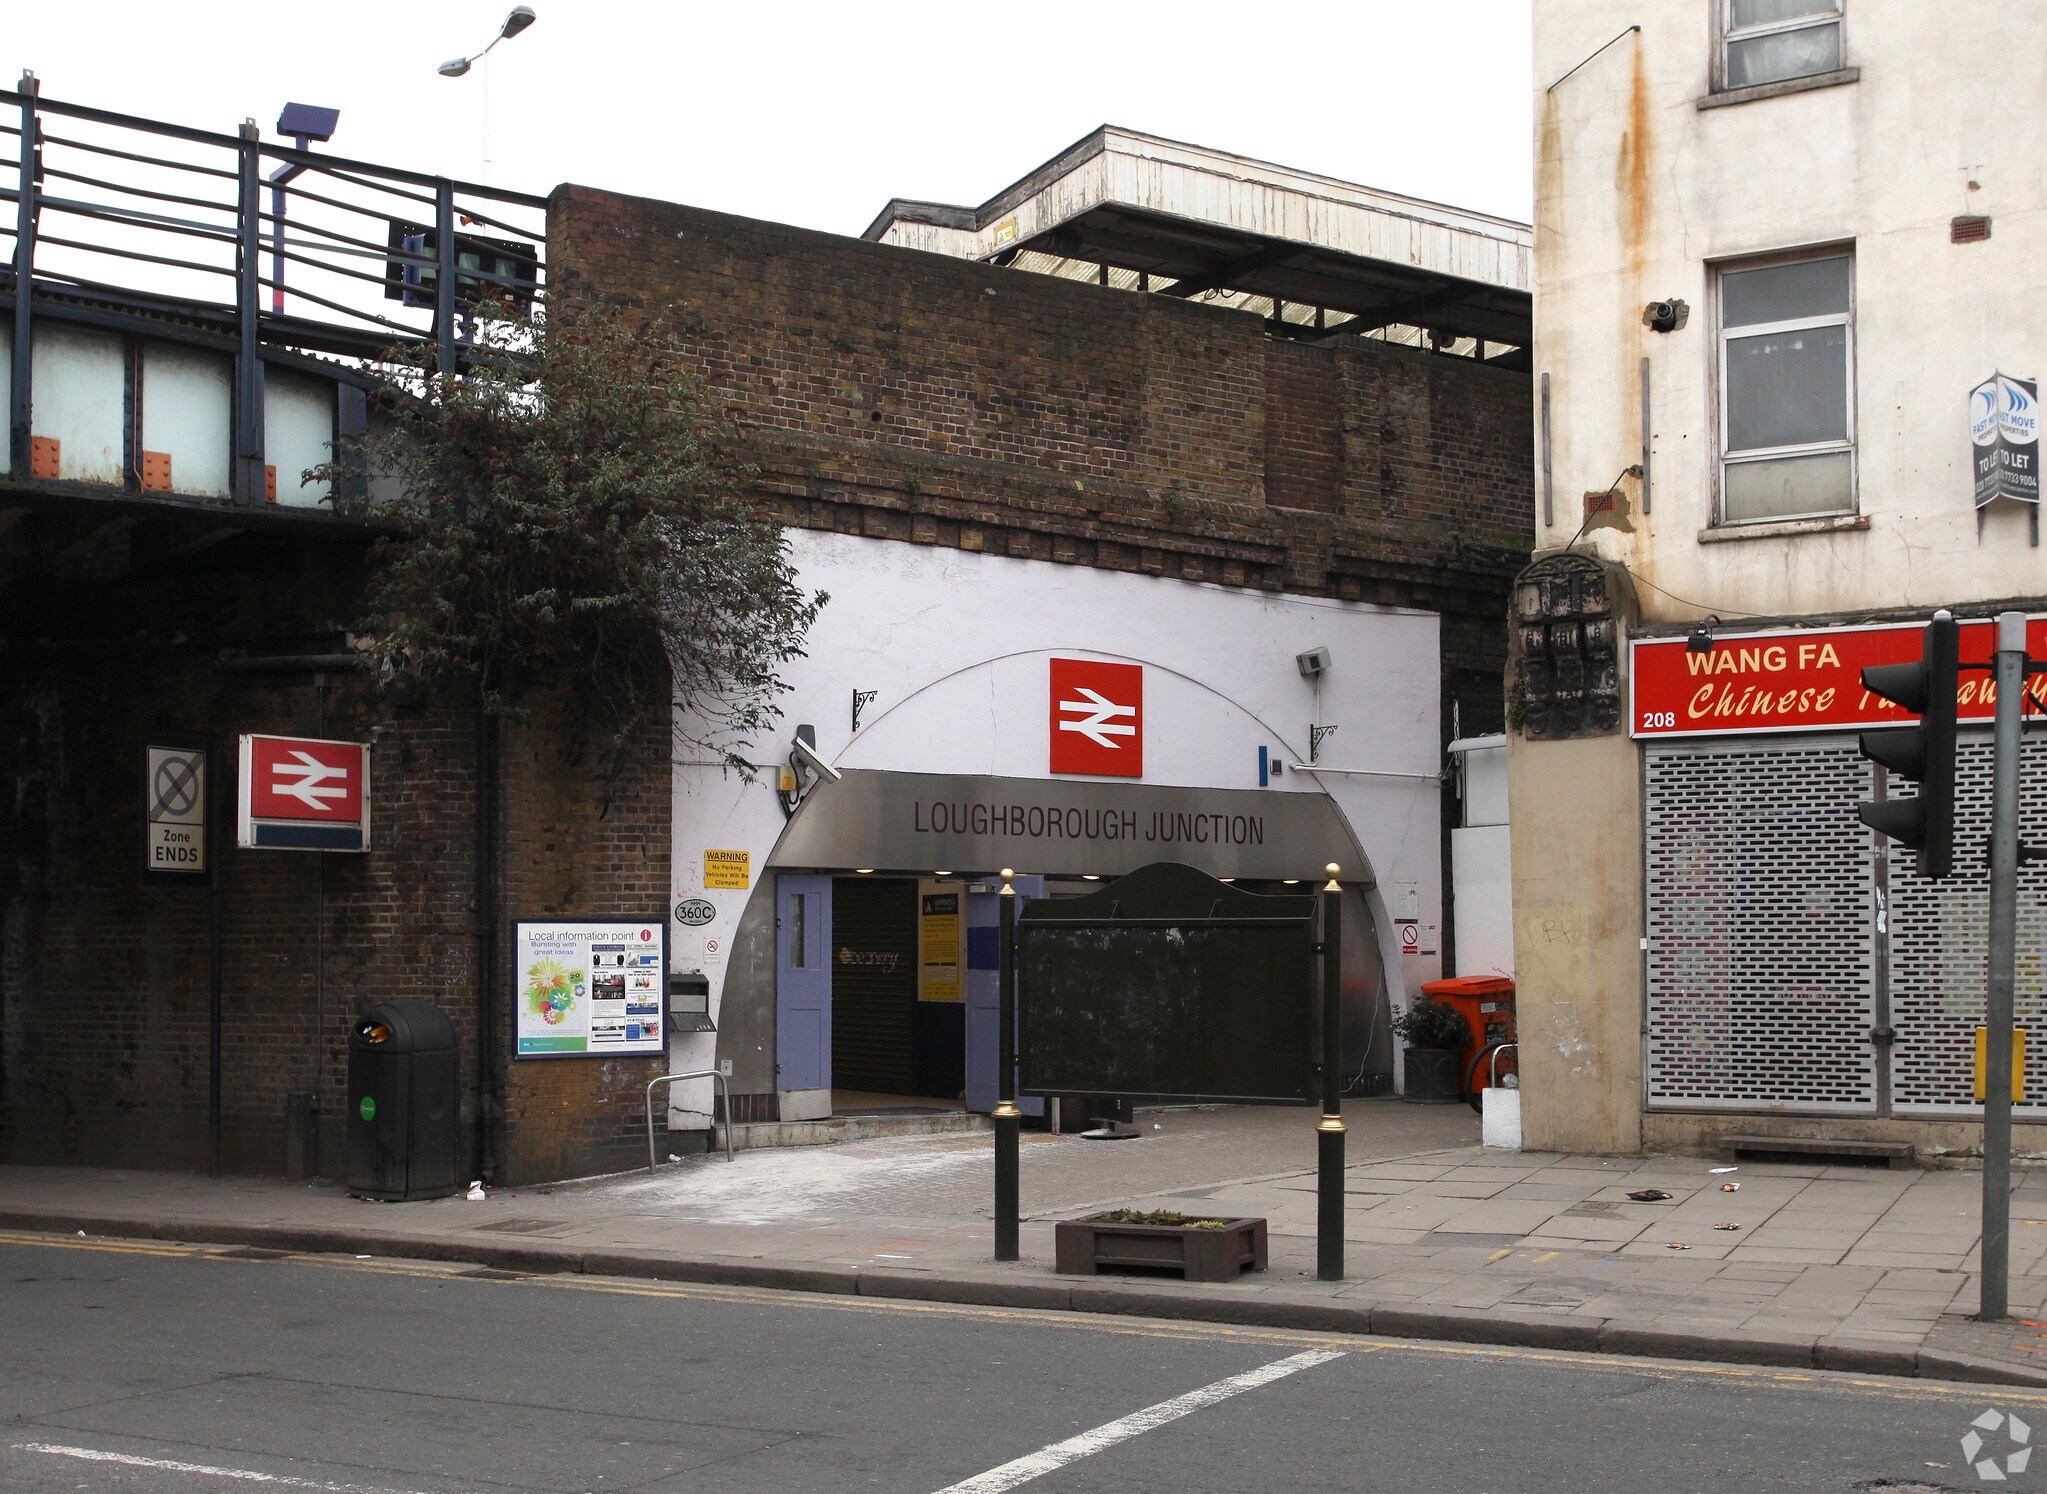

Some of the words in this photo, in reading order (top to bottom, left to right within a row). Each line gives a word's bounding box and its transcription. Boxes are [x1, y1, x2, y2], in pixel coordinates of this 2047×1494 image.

[1973, 418, 1988, 436] FAST
[2011, 416, 2035, 428] MOVE
[1979, 458, 1988, 473] TO
[1990, 449, 1998, 468] LE
[2001, 449, 2009, 465] TO
[2012, 453, 2029, 469] LET
[1686, 646, 1787, 676] WANG
[1798, 642, 1841, 670] FA
[1687, 681, 1836, 719] Chinese
[1643, 712, 1675, 728] 208
[914, 801, 1138, 841] LOUGHBOROUGH
[1145, 812, 1264, 845] JUNCTION
[163, 829, 191, 843] Zone
[156, 846, 198, 863] ENDS
[707, 851, 748, 862] WARNING
[721, 864, 742, 872] Parking
[679, 906, 712, 919] 360C
[528, 930, 555, 941] Local
[557, 930, 609, 941] information
[611, 931, 635, 943] point
[531, 941, 561, 949] Bursting
